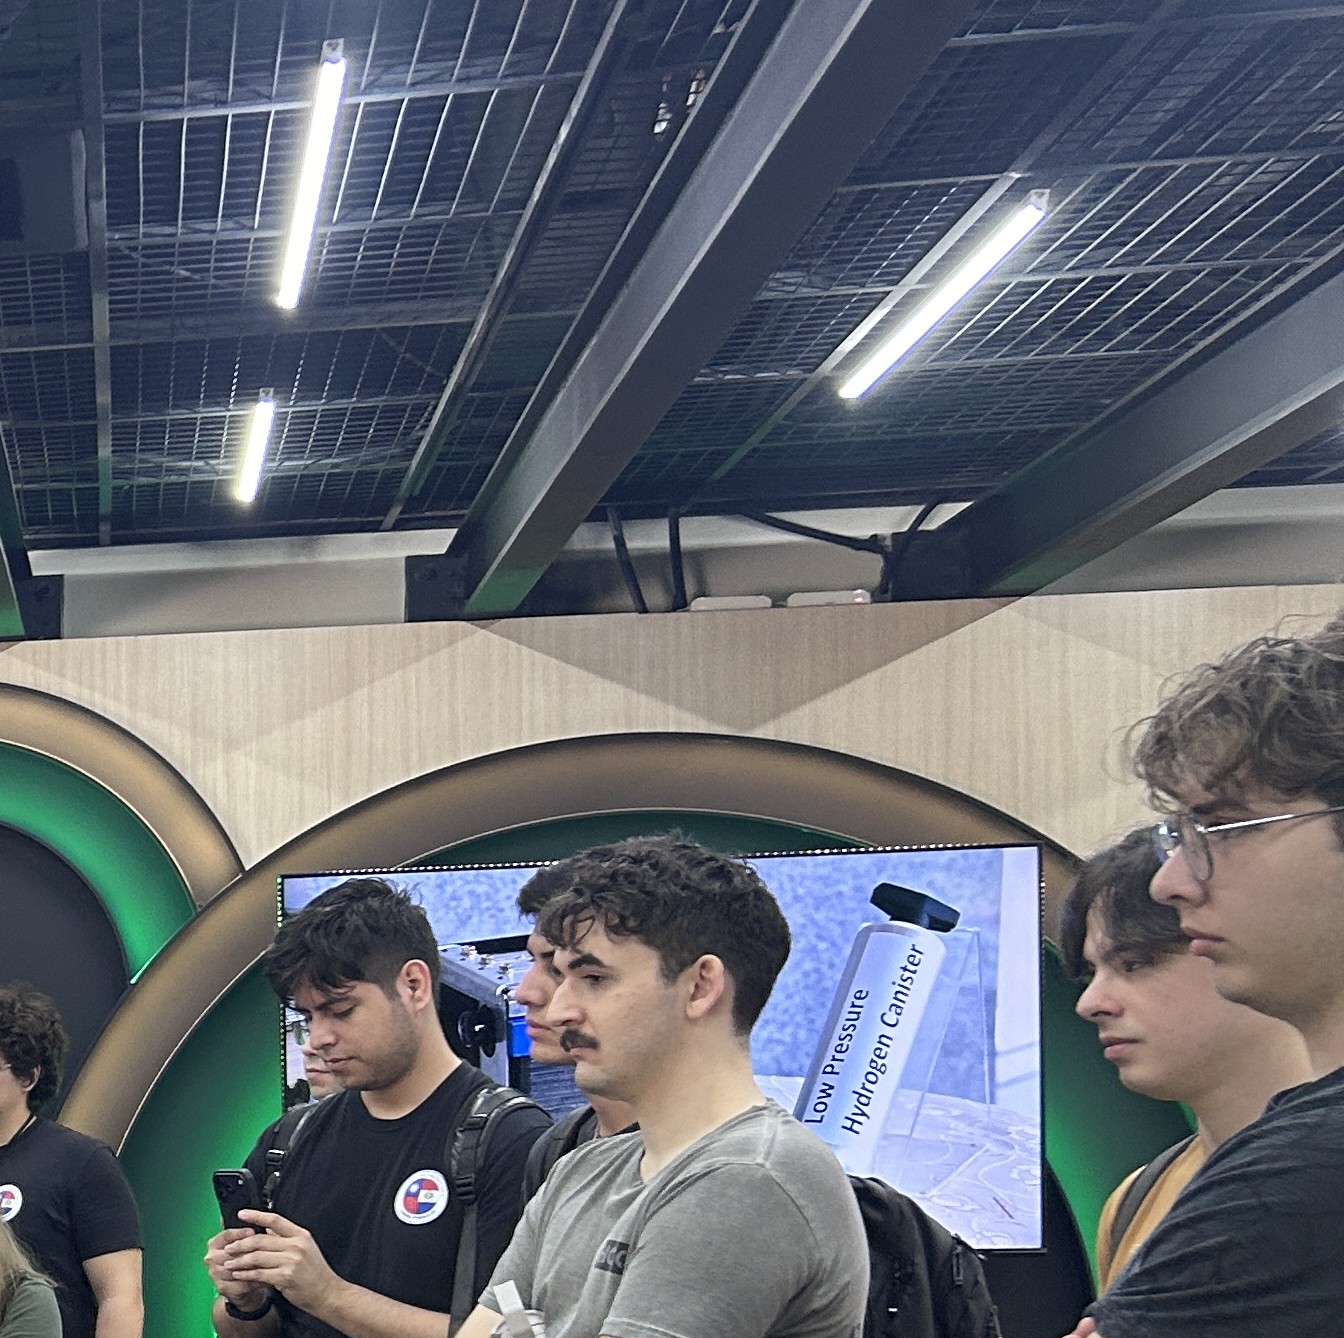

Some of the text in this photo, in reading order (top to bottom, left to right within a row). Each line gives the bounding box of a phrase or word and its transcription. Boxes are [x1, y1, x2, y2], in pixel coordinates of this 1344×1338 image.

[804, 988, 870, 1124] Low Pressure
[841, 943, 924, 1135] Hydrogen Canister
